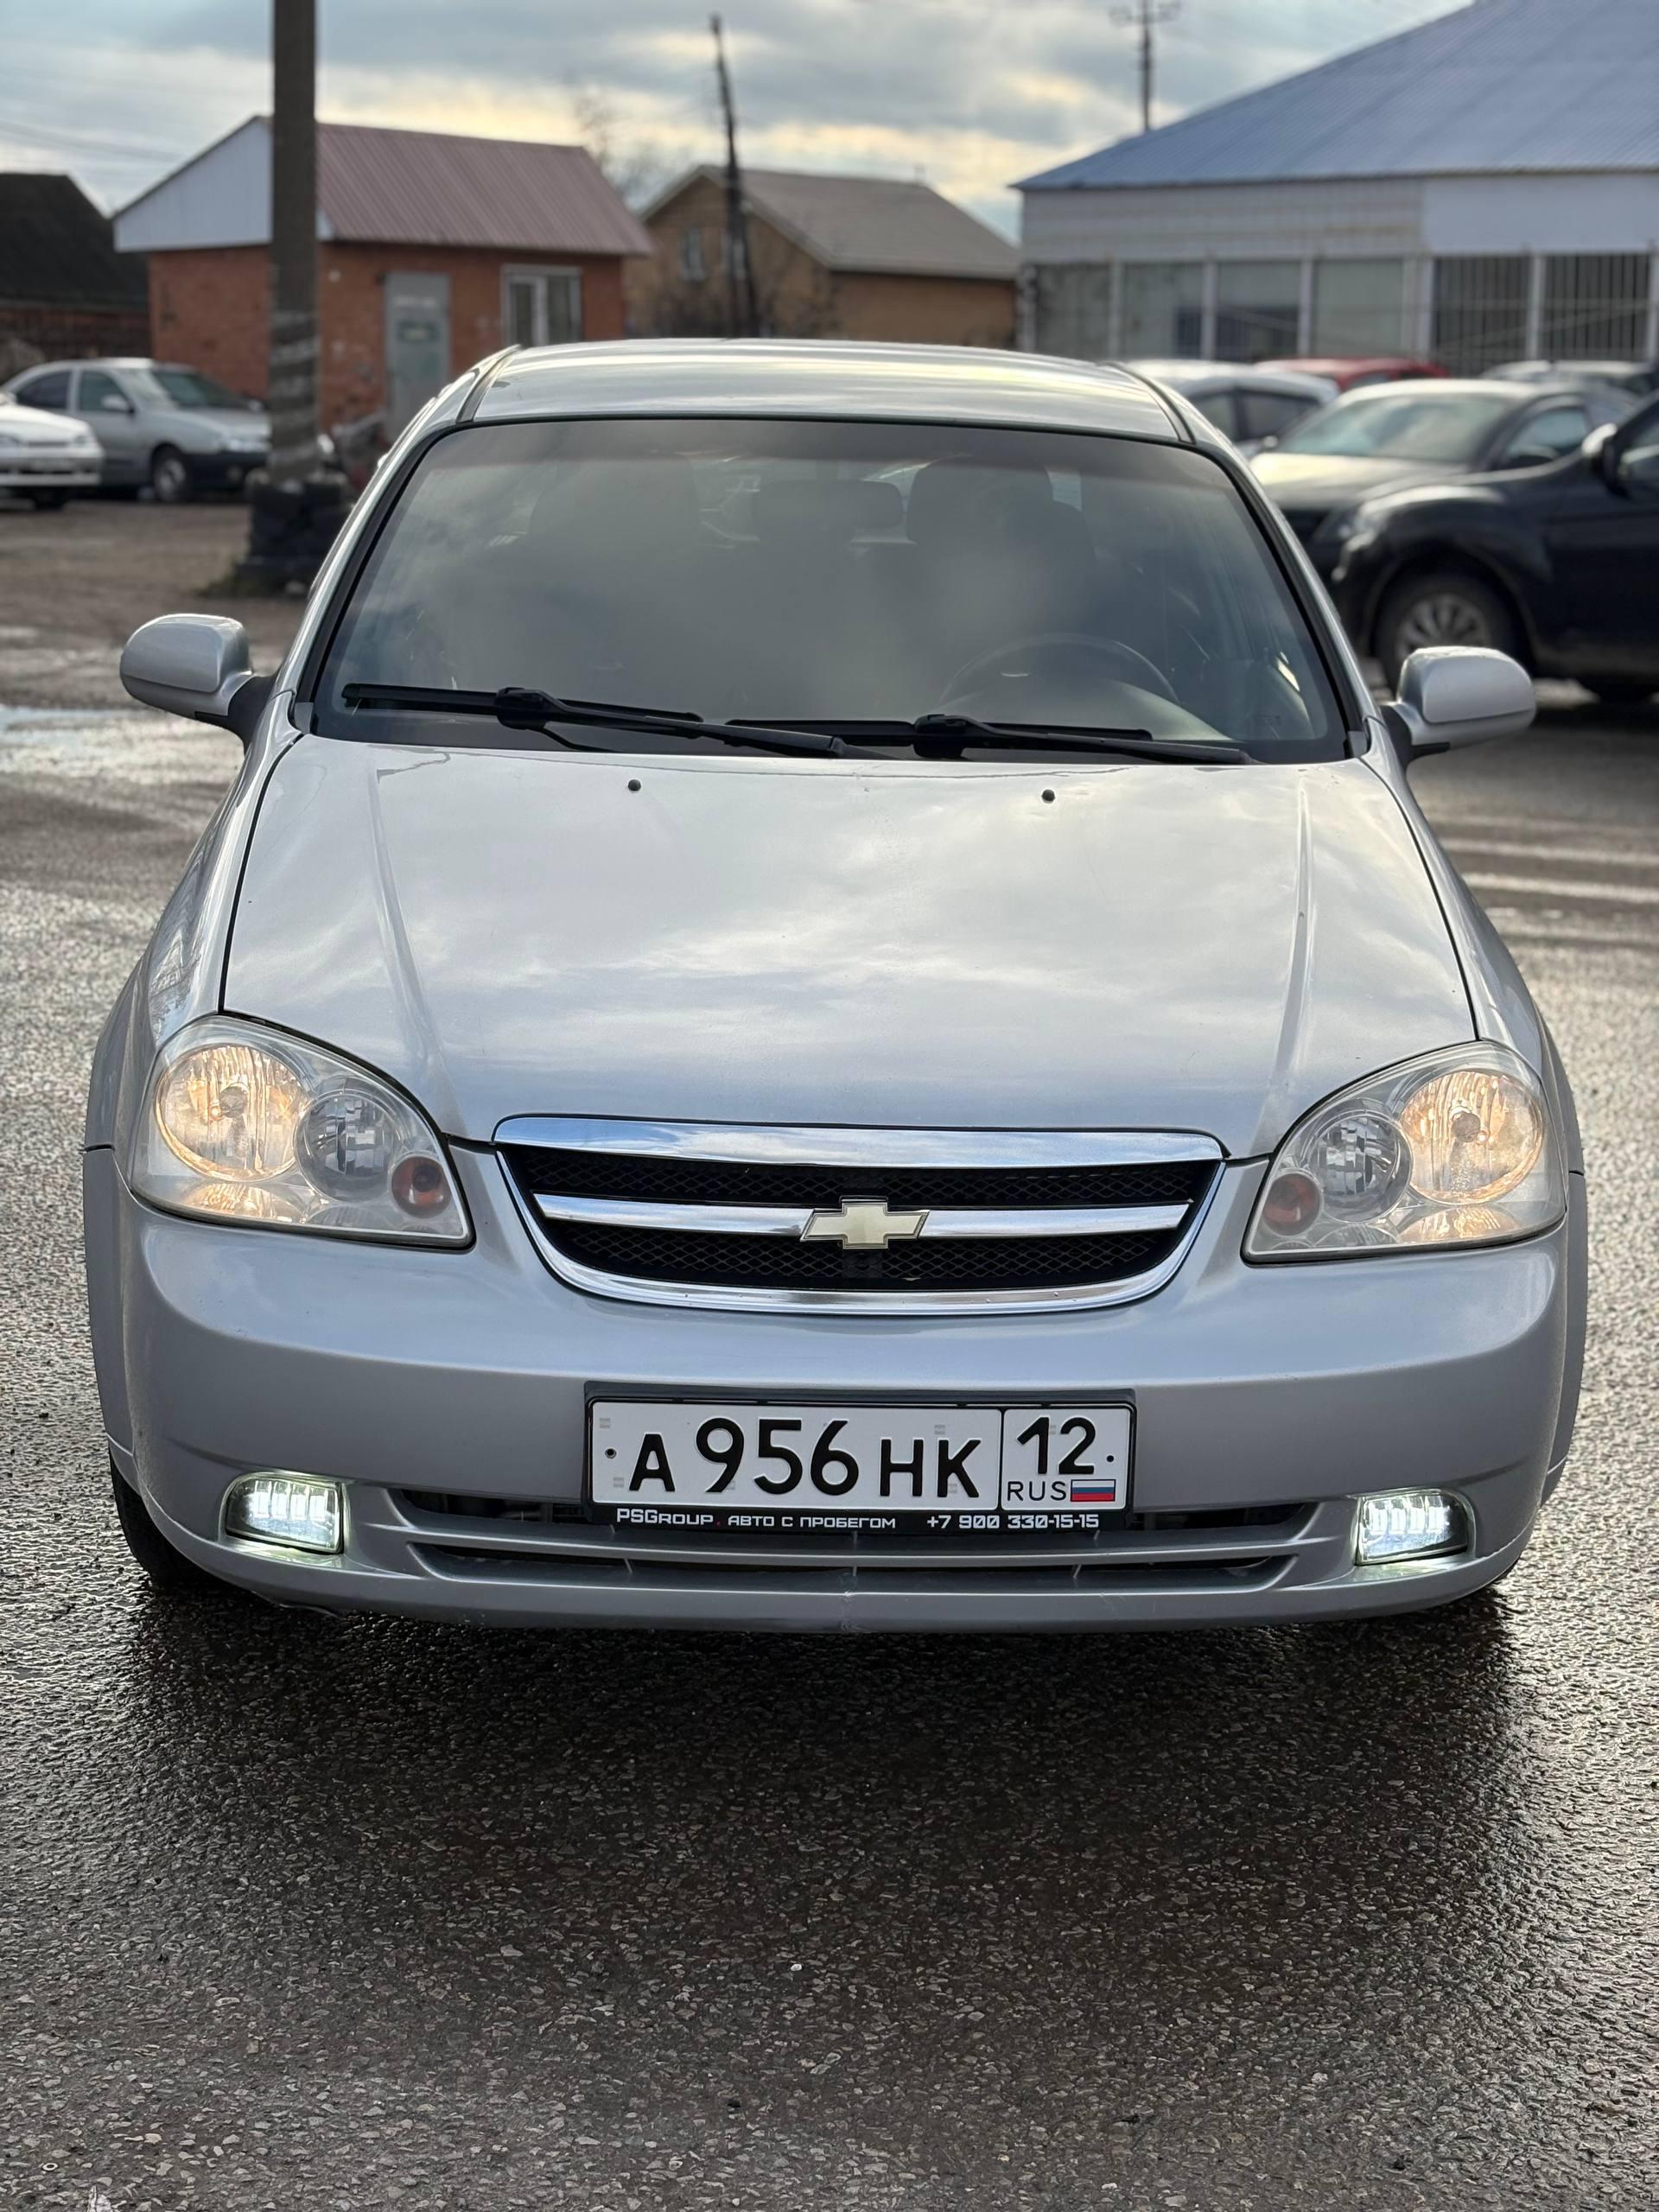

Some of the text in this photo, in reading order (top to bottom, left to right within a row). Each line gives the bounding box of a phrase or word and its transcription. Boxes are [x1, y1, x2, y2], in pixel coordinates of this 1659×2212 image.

[1016, 1416, 1096, 1476] 12
[1007, 1480, 1067, 1502] RUS
[926, 1515, 951, 1529] +7
[958, 1515, 1000, 1529] 900
[1007, 1514, 1099, 1529] 330-15-15
